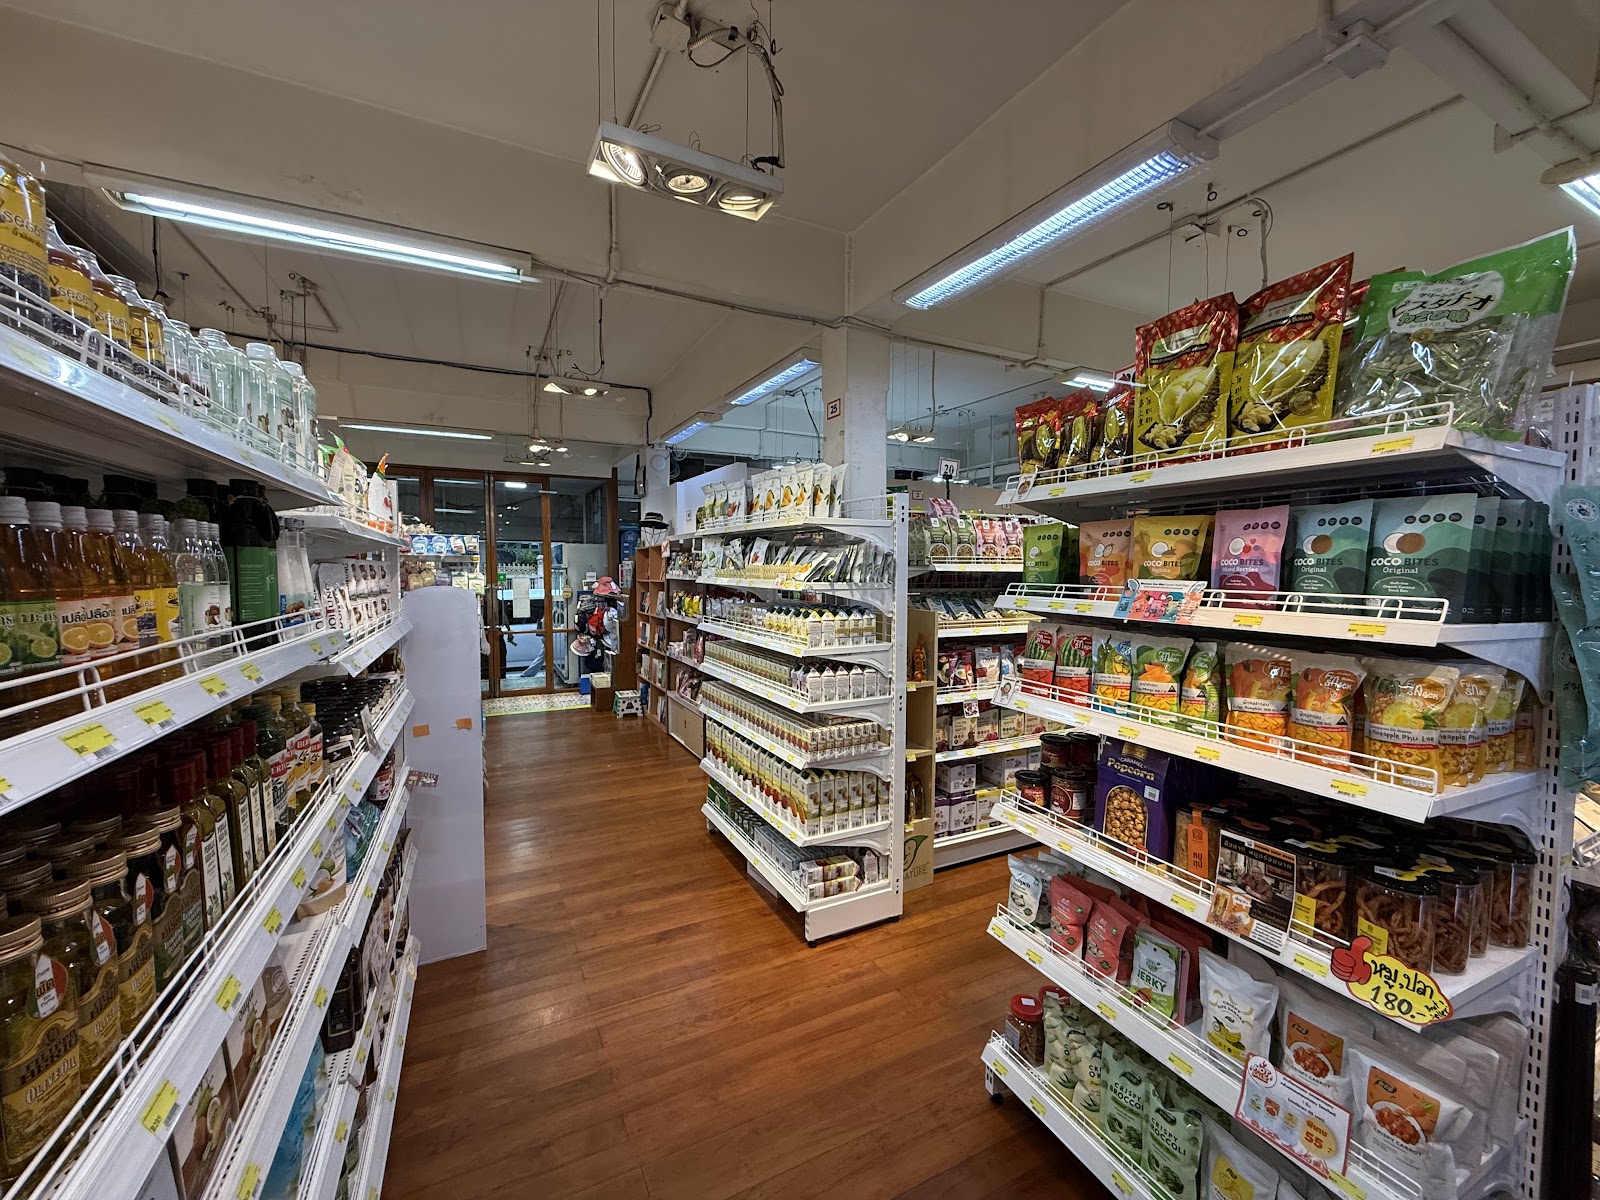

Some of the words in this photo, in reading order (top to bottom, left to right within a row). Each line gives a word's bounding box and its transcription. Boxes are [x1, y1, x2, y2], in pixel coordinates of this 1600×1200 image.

[1392, 290, 1494, 319] ピスタチオ
[830, 404, 838, 414] 25
[944, 463, 954, 475] 20
[1220, 558, 1238, 566] COCO
[1240, 558, 1264, 566] BITES
[1293, 557, 1315, 566] COCO
[1316, 558, 1343, 566] BITES
[1370, 557, 1401, 566] COCO
[1404, 557, 1439, 566] BITES
[1382, 566, 1418, 575] Original
[1371, 729, 1400, 740] Pineapple
[1401, 732, 1419, 742] Phu
[1421, 734, 1435, 742] Lae
[1107, 757, 1155, 781] Popcorn
[1119, 757, 1144, 769] CARAMEL
[1136, 969, 1167, 993] JERKY
[1254, 1062, 1272, 1077] HOT
[25, 1067, 61, 1104] OLIVE
[60, 1055, 77, 1077] OIL
[1114, 1082, 1142, 1102] CRISPY
[1151, 1117, 1180, 1143] CRISPY
[1304, 1130, 1324, 1149] 55
[1395, 1140, 1423, 1157] CARROT
